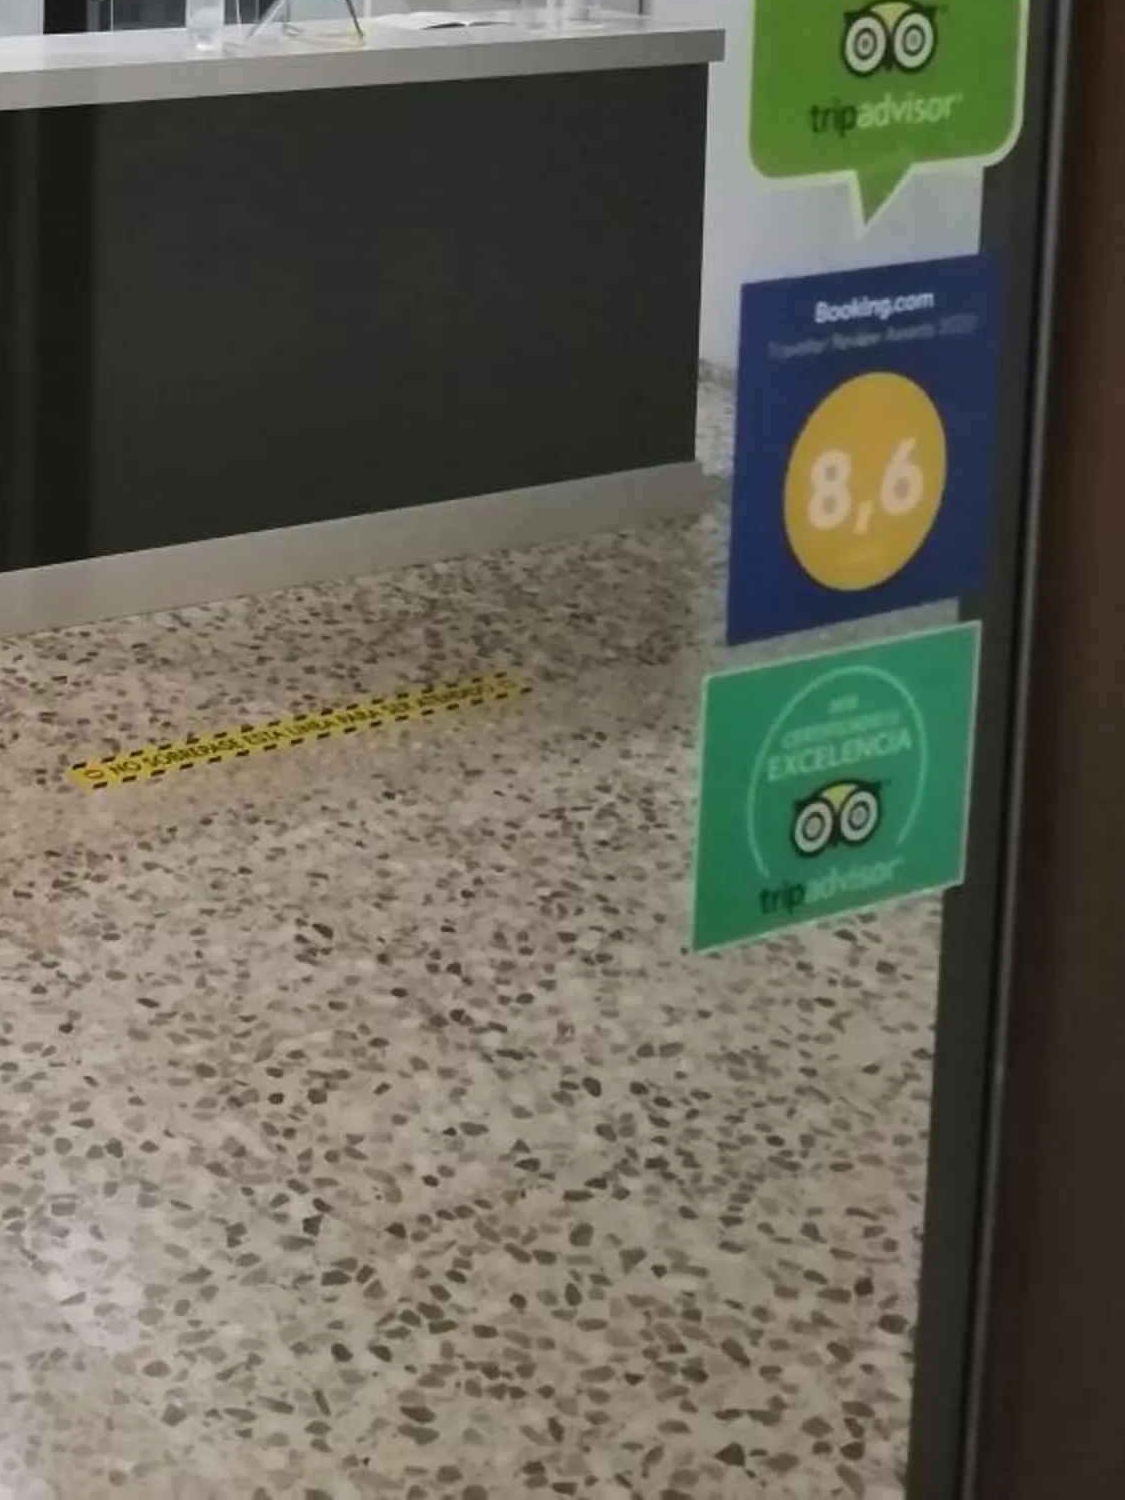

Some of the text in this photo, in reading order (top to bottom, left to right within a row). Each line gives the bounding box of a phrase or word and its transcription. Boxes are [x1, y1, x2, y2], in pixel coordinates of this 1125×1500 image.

[809, 93, 955, 138] tripadvisor
[814, 292, 935, 323] Booking.com
[807, 437, 925, 535] 8,6
[109, 760, 142, 776] NO
[767, 727, 912, 782] EXCELENCIA
